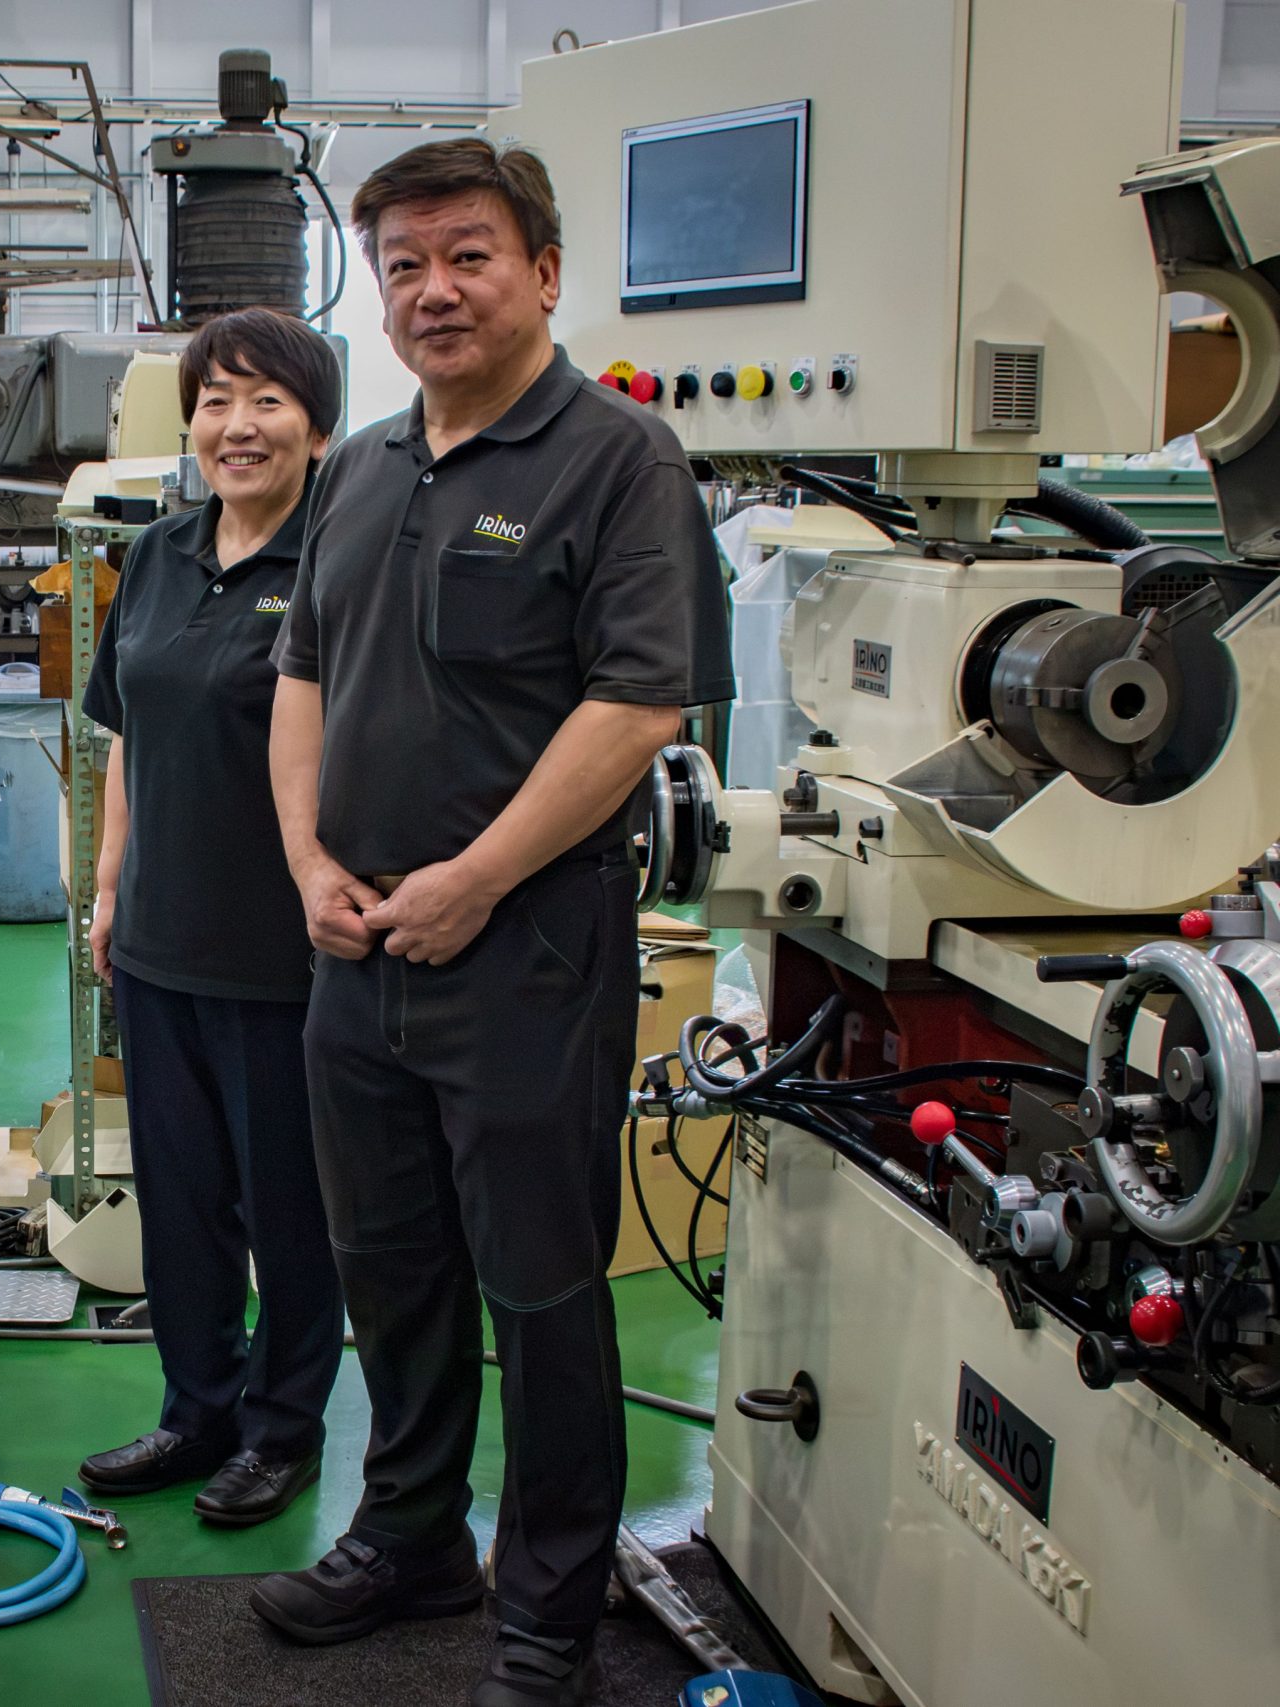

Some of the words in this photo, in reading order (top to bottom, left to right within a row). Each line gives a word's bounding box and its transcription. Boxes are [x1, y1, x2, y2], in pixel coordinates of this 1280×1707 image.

[475, 513, 526, 541] IRINO
[855, 642, 887, 674] IRINO
[963, 1388, 1043, 1492] IRINO
